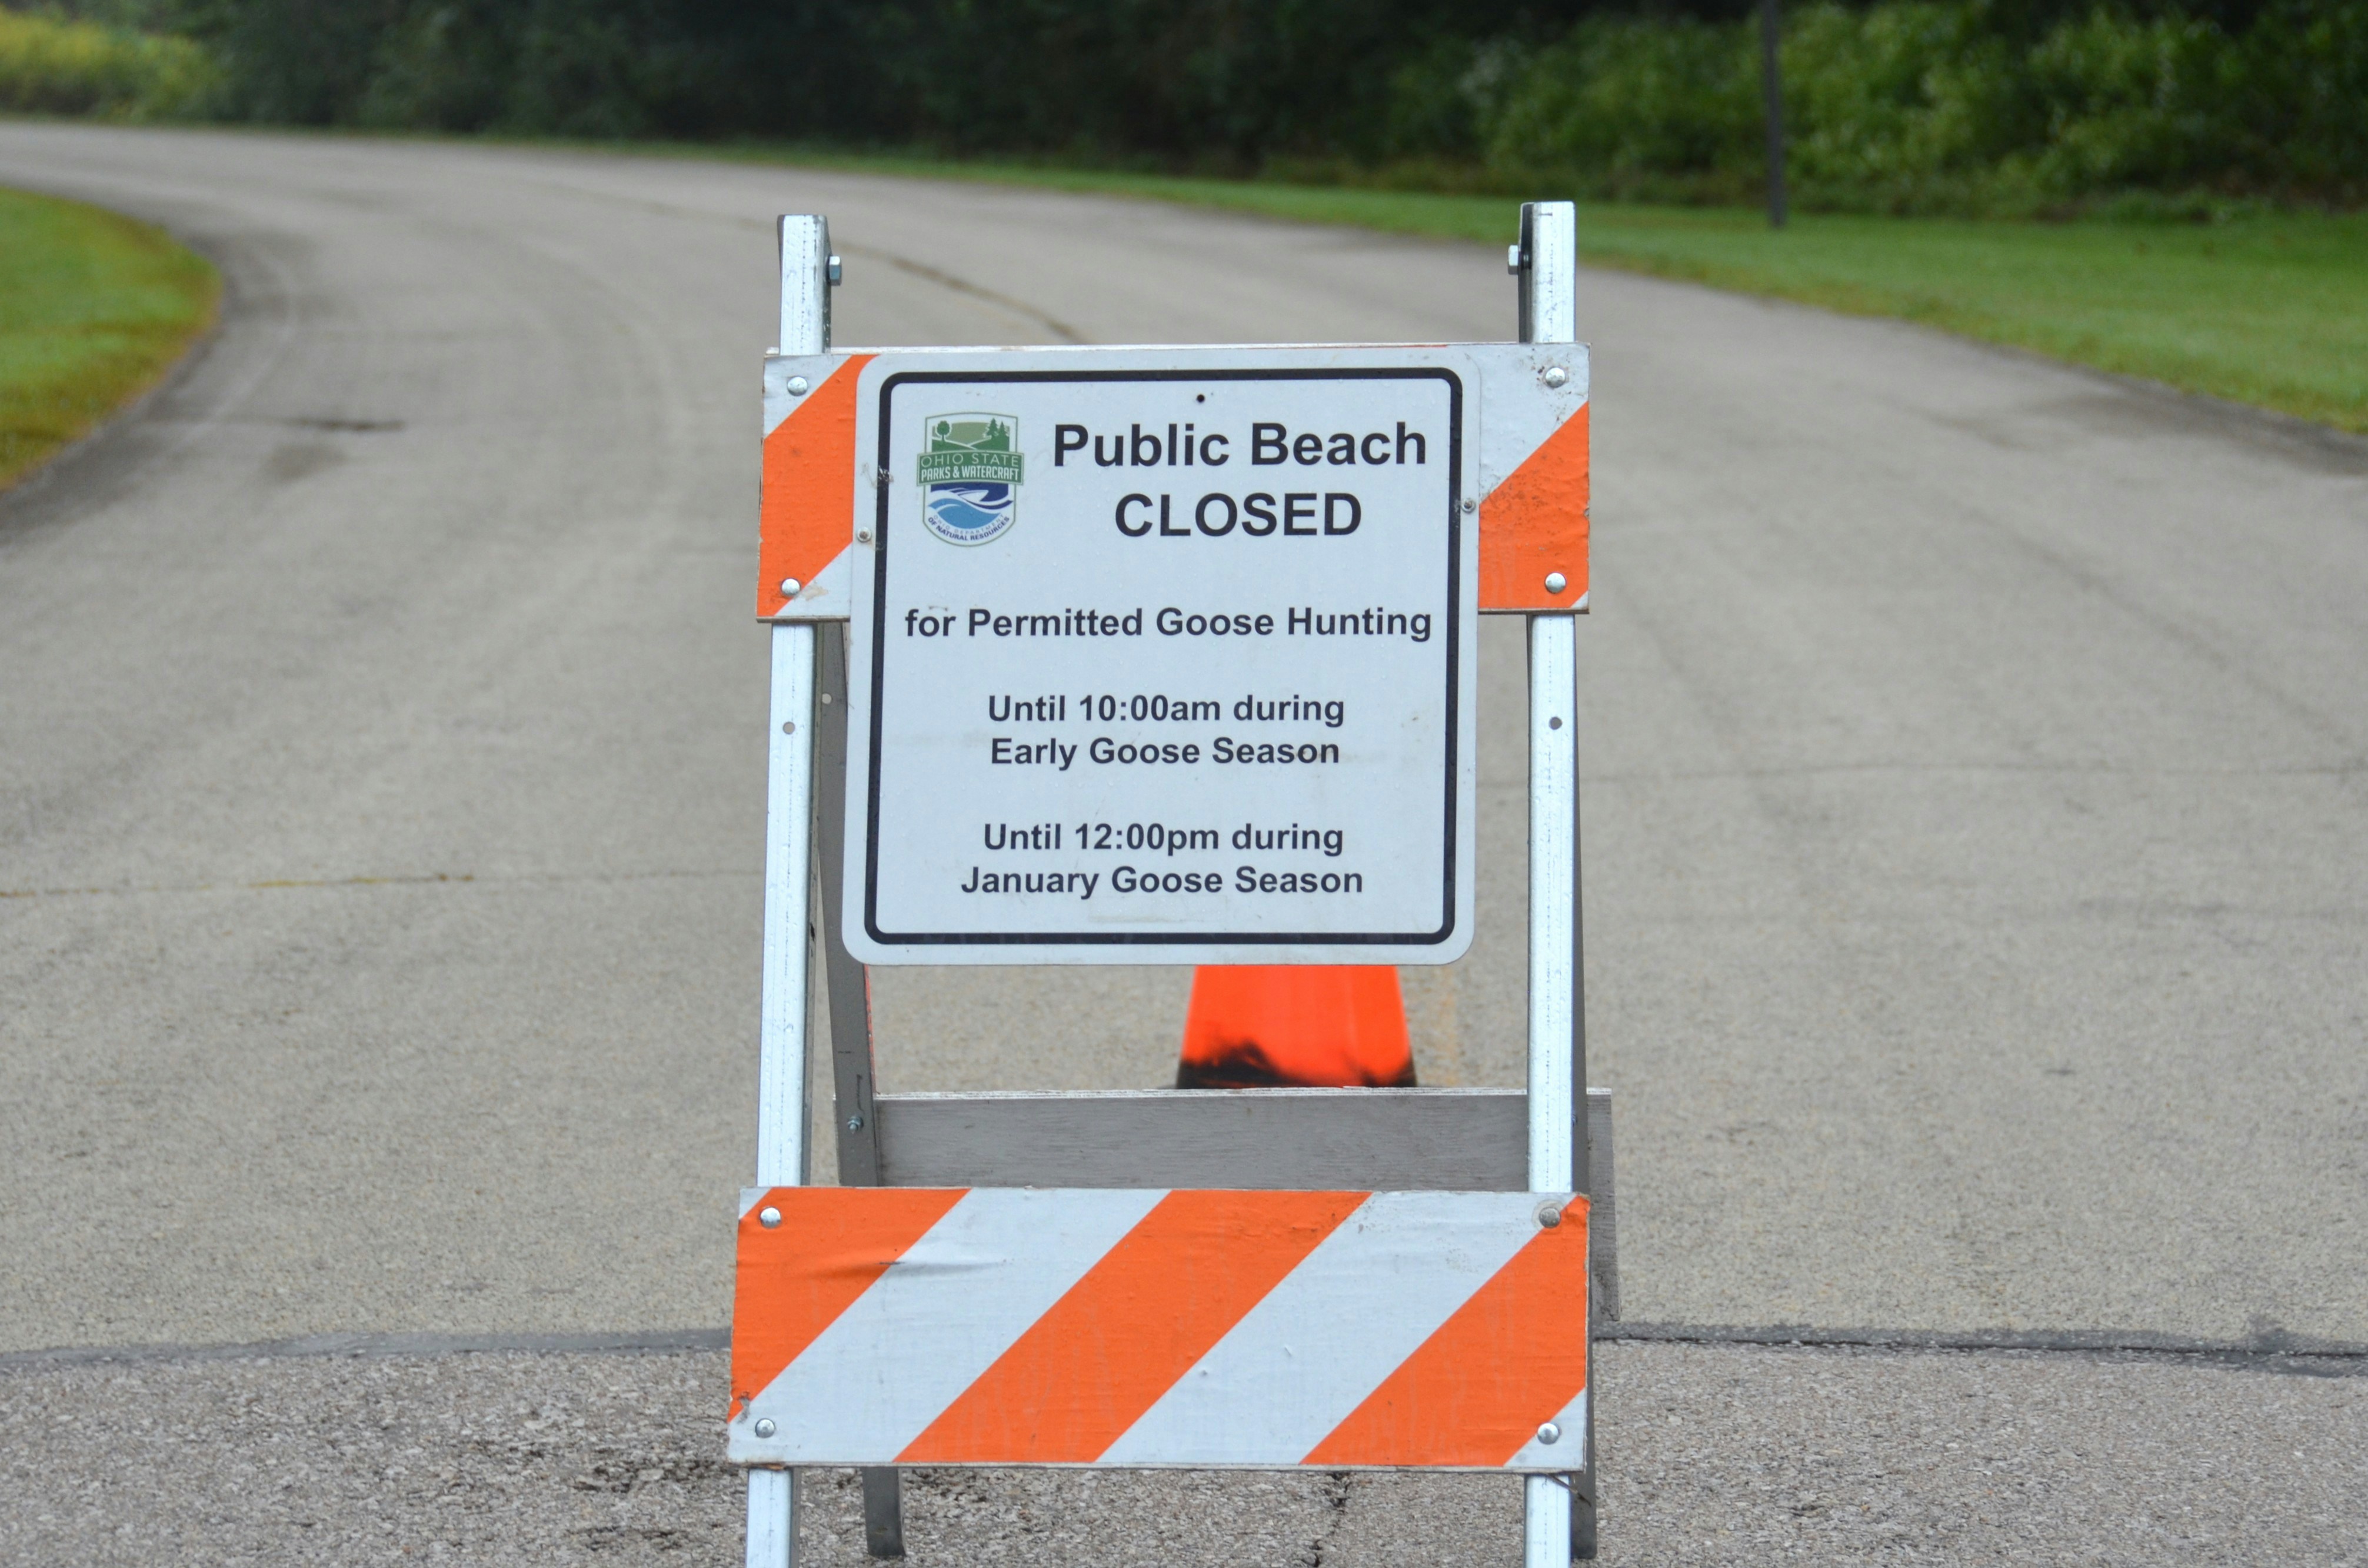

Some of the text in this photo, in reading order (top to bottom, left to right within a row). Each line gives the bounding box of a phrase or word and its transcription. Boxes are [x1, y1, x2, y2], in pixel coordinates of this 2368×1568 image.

[921, 453, 1019, 468] OHIO STATE
[1054, 421, 1426, 467] Public Beach
[921, 465, 1020, 482] PARKS & WATERCRAFT
[928, 516, 1010, 541] OF NATURAL RESOURCES
[1115, 492, 1361, 537] CLOSED
[905, 607, 1431, 642] for Permitted Goose Hunting
[989, 694, 1344, 728] Until 10:00am during
[991, 737, 1339, 771] Early Goose Season
[984, 823, 1343, 857] Until 12:00pm during
[961, 865, 1363, 900] January Goose Season
